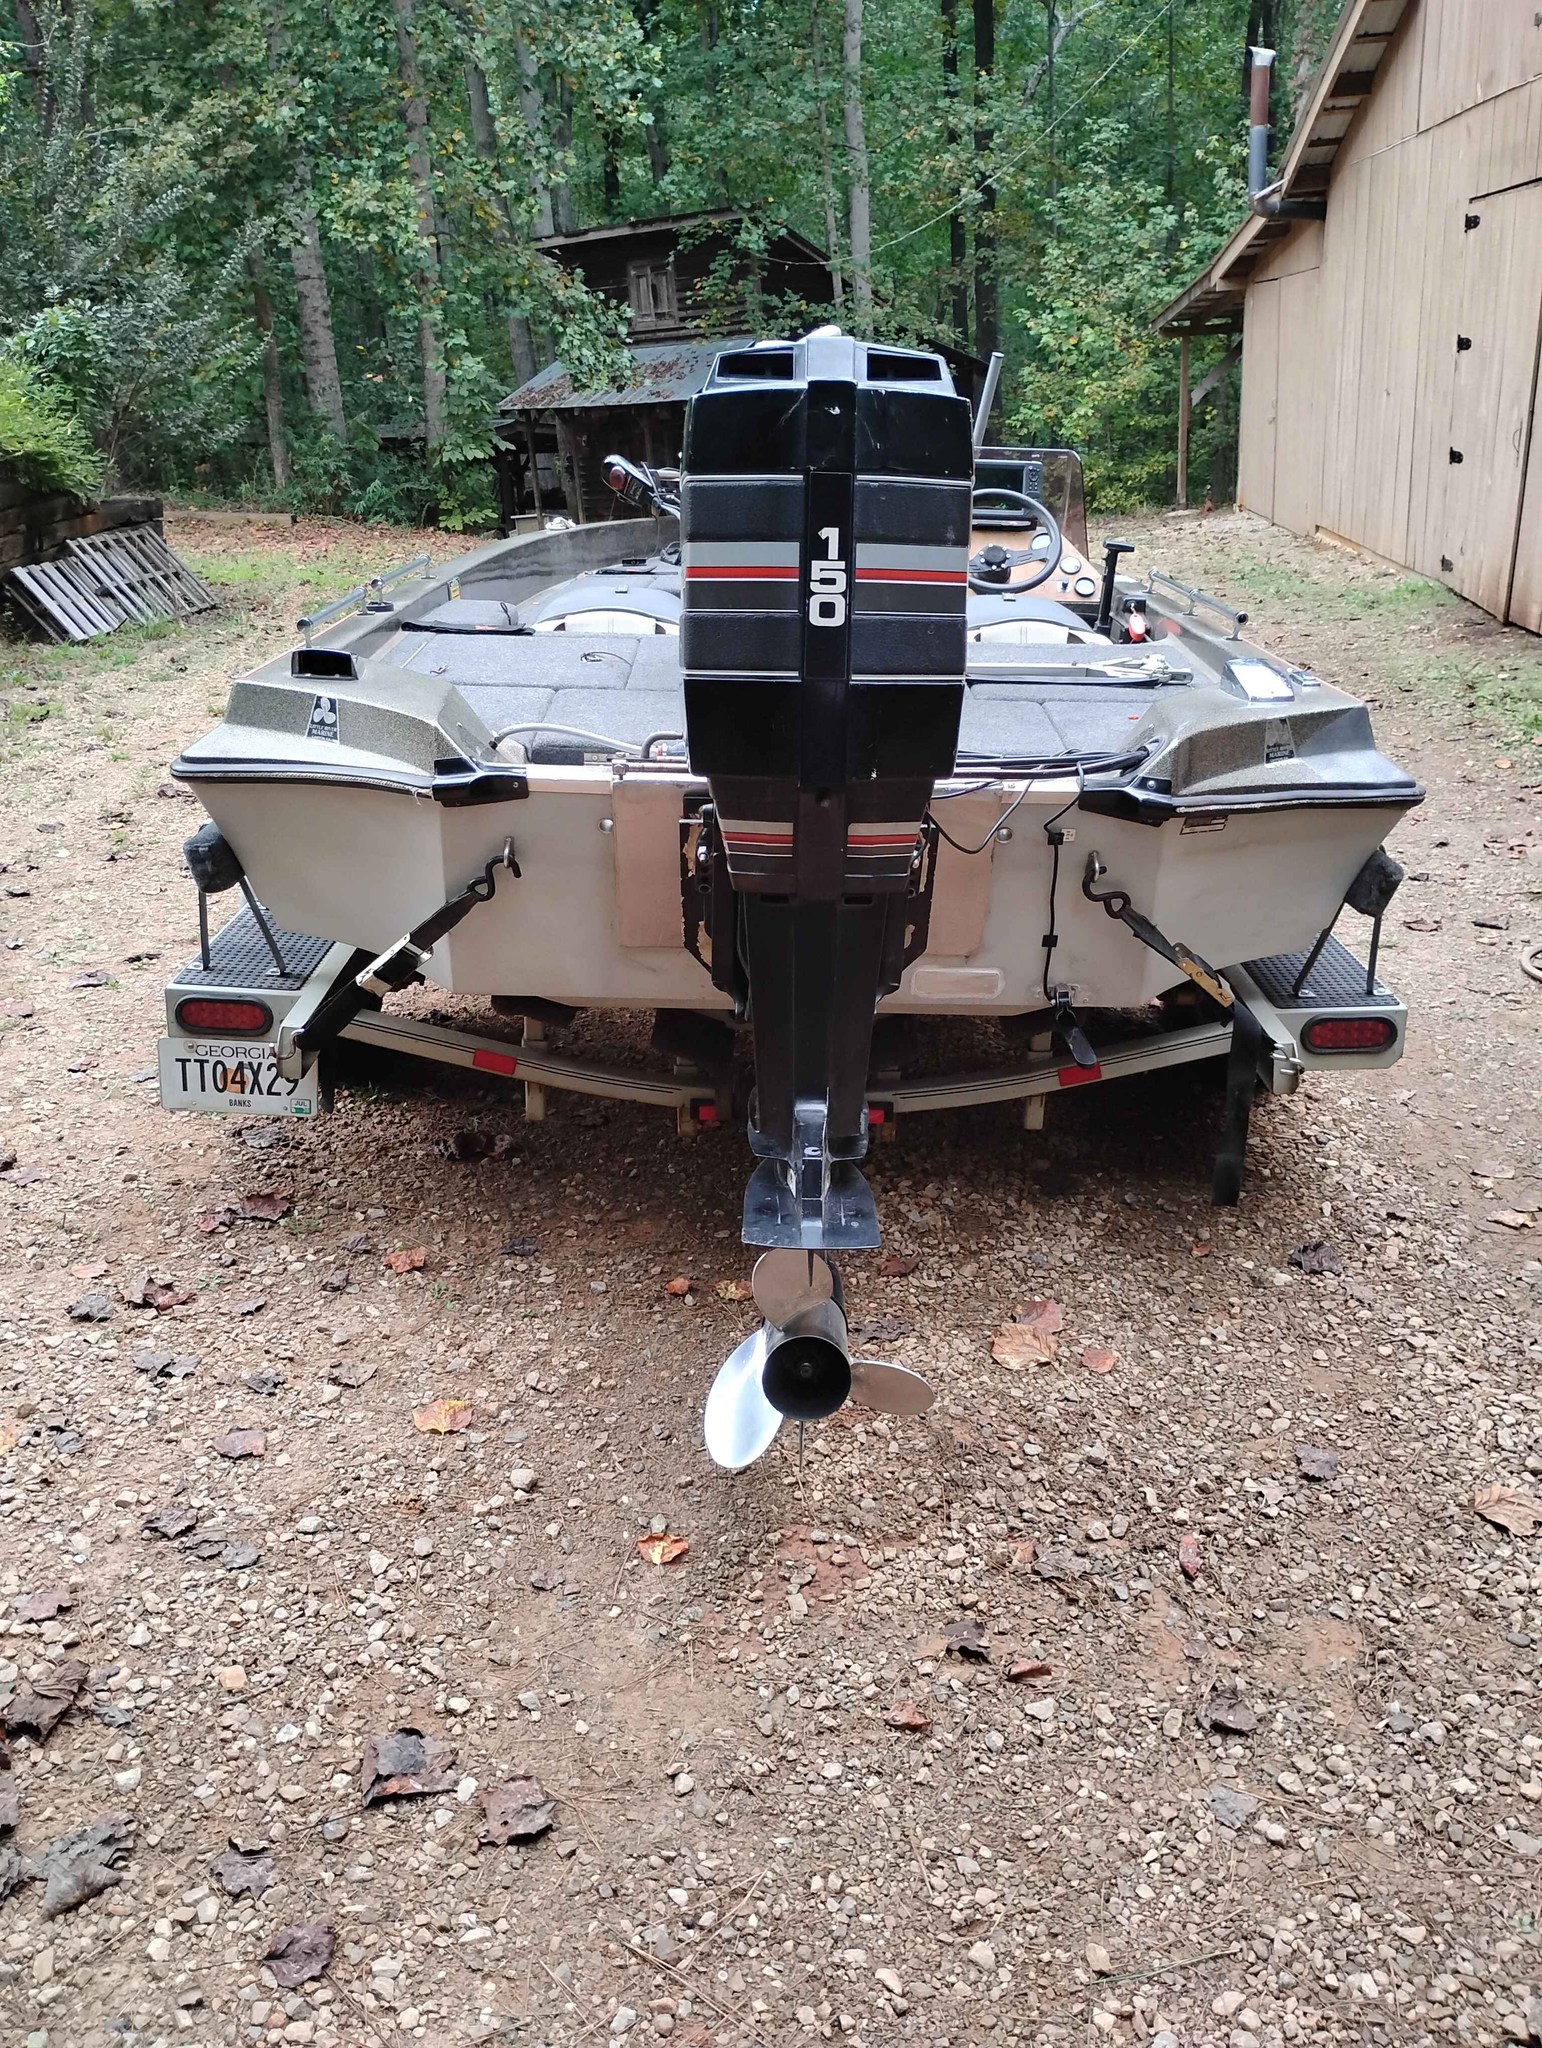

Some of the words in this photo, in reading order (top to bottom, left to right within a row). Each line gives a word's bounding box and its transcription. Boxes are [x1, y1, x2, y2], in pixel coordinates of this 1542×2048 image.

[810, 527, 847, 627] 150
[312, 729, 334, 737] MARINE
[228, 1098, 251, 1107] BANKS
